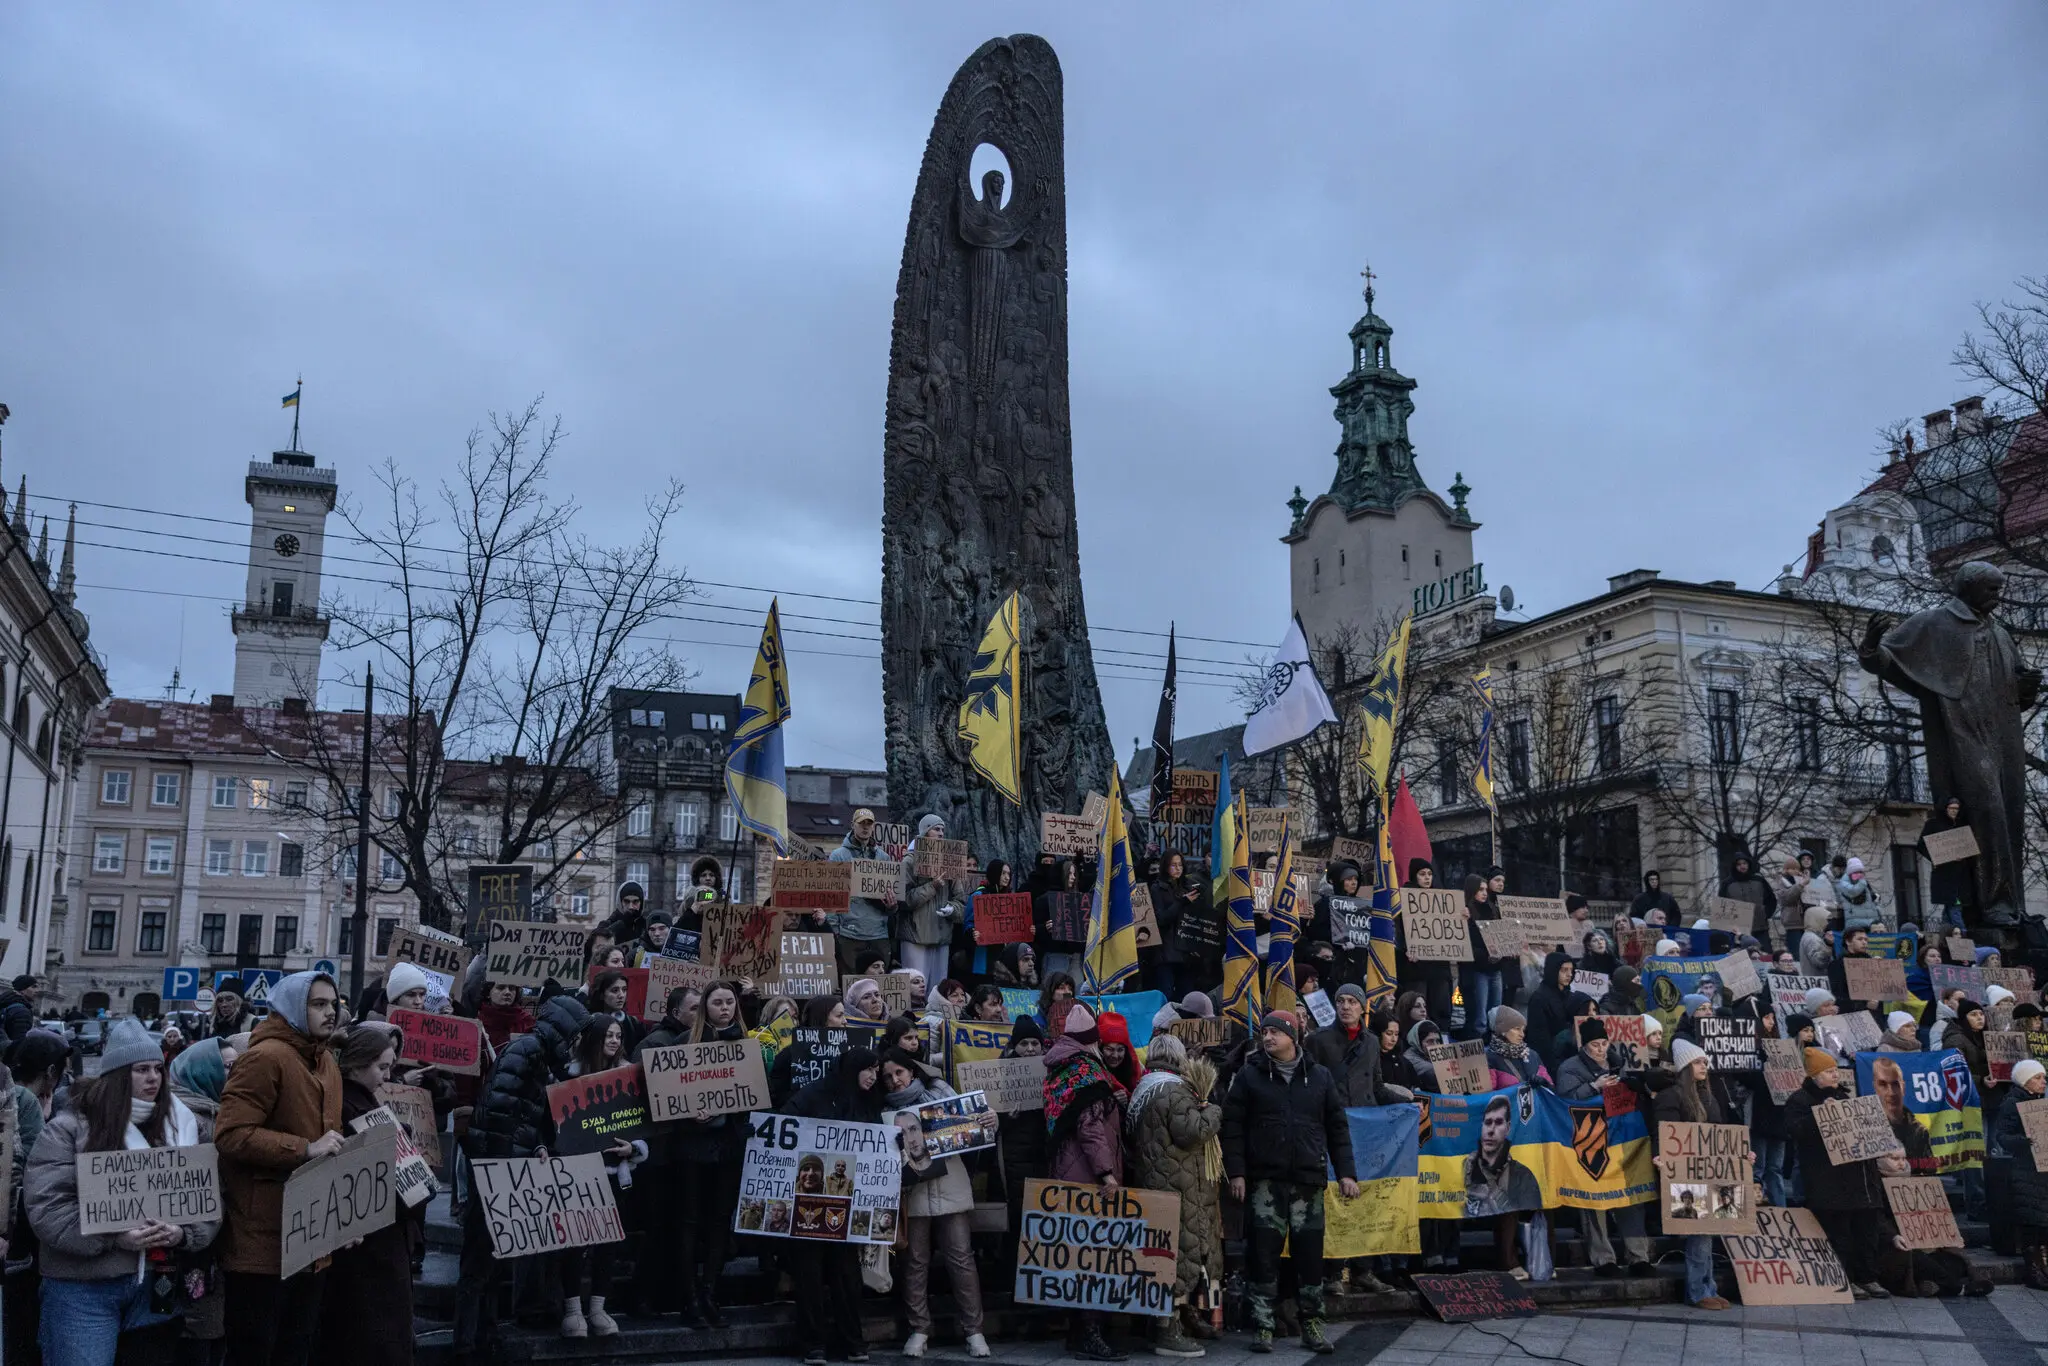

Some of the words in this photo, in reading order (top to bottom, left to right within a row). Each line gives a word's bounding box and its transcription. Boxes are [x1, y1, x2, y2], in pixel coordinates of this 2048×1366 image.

[1414, 562, 1487, 617] HOTEL
[1174, 774, 1210, 788] ЕРНІТЬ
[874, 823, 908, 845] ОЛОН
[1048, 833, 1066, 842] ТРИ
[1071, 835, 1093, 844] РОКИ
[853, 861, 900, 876] МОВЧАННЯ
[480, 873, 521, 904] FREE
[861, 878, 899, 895] ВБИВАЄ
[1331, 898, 1358, 913] СТАНЬ
[1408, 892, 1455, 914] ВОЛЮ
[1345, 913, 1372, 929] ГОЛОС
[1410, 918, 1466, 940] АЗОВУ
[560, 931, 585, 946] ХТО
[1349, 930, 1370, 946] ПОЛО
[397, 938, 460, 972] ДЕНЬ
[523, 945, 547, 956] БУВ
[489, 954, 580, 980] ЩИТОМ
[751, 950, 777, 978] AZOV
[172, 971, 193, 997] P
[764, 978, 832, 995] ПОЛОНЕНИМ
[883, 975, 906, 991] ДЕНЬ
[421, 1017, 459, 1040] МОВЧИ
[805, 1030, 820, 1043] НИХ
[828, 1030, 848, 1045] ОДНА
[1700, 1018, 1732, 1036] ПОКИ
[1738, 1018, 1756, 1036] ТИ
[811, 1044, 841, 1057] ЄДИНА
[954, 1028, 1012, 1050] АЗО
[651, 1050, 688, 1073] АЗОВ
[694, 1044, 746, 1066] ЗРОБИВ
[1716, 1053, 1763, 1070] КАТУЮТЬ
[680, 1067, 735, 1084] НЕМОЖЛИВЕ
[668, 1095, 690, 1115] ВИ
[696, 1083, 758, 1112] ЗРОБІТЬ
[1911, 1071, 1943, 1104] 58
[581, 1115, 606, 1129] БУДЬ
[611, 1106, 646, 1121] ГОЛОСОМ
[596, 1117, 643, 1135] ПОЛОНЕНИХ
[756, 1116, 800, 1150] 46
[815, 1125, 888, 1153] БРИГАДА
[1666, 1124, 1694, 1157] 31
[1697, 1124, 1749, 1160] МІСЯЦЬ
[1826, 1137, 1847, 1152] СИН
[91, 1149, 187, 1175] БАЙДУЖІСТЬ
[108, 1175, 139, 1196] КУЄ
[147, 1168, 212, 1190] КАЙДАНИ
[473, 1159, 535, 1194] ТИ
[550, 1157, 574, 1188] В
[745, 1178, 795, 1200] БРАТА!
[1891, 1183, 1946, 1213] ПОЛОН
[86, 1196, 147, 1223] НАШИХ
[158, 1189, 217, 1217] ГЕРОЇВ
[492, 1214, 556, 1255] ВОНИ
[552, 1212, 567, 1244] В
[1025, 1213, 1144, 1251] ГОЛОСОМ
[1143, 1227, 1172, 1250] ТИХ
[1757, 1208, 1801, 1238] РІЯ
[1900, 1213, 1956, 1242] ВБИВАЄ
[1022, 1240, 1070, 1270] ХТО
[1077, 1245, 1137, 1276] СТАВ
[1724, 1234, 1837, 1264] ПОВЕРНЕННЯ
[1735, 1260, 1795, 1285] ТАТА
[1107, 1270, 1177, 1311] ЩИТОМ
